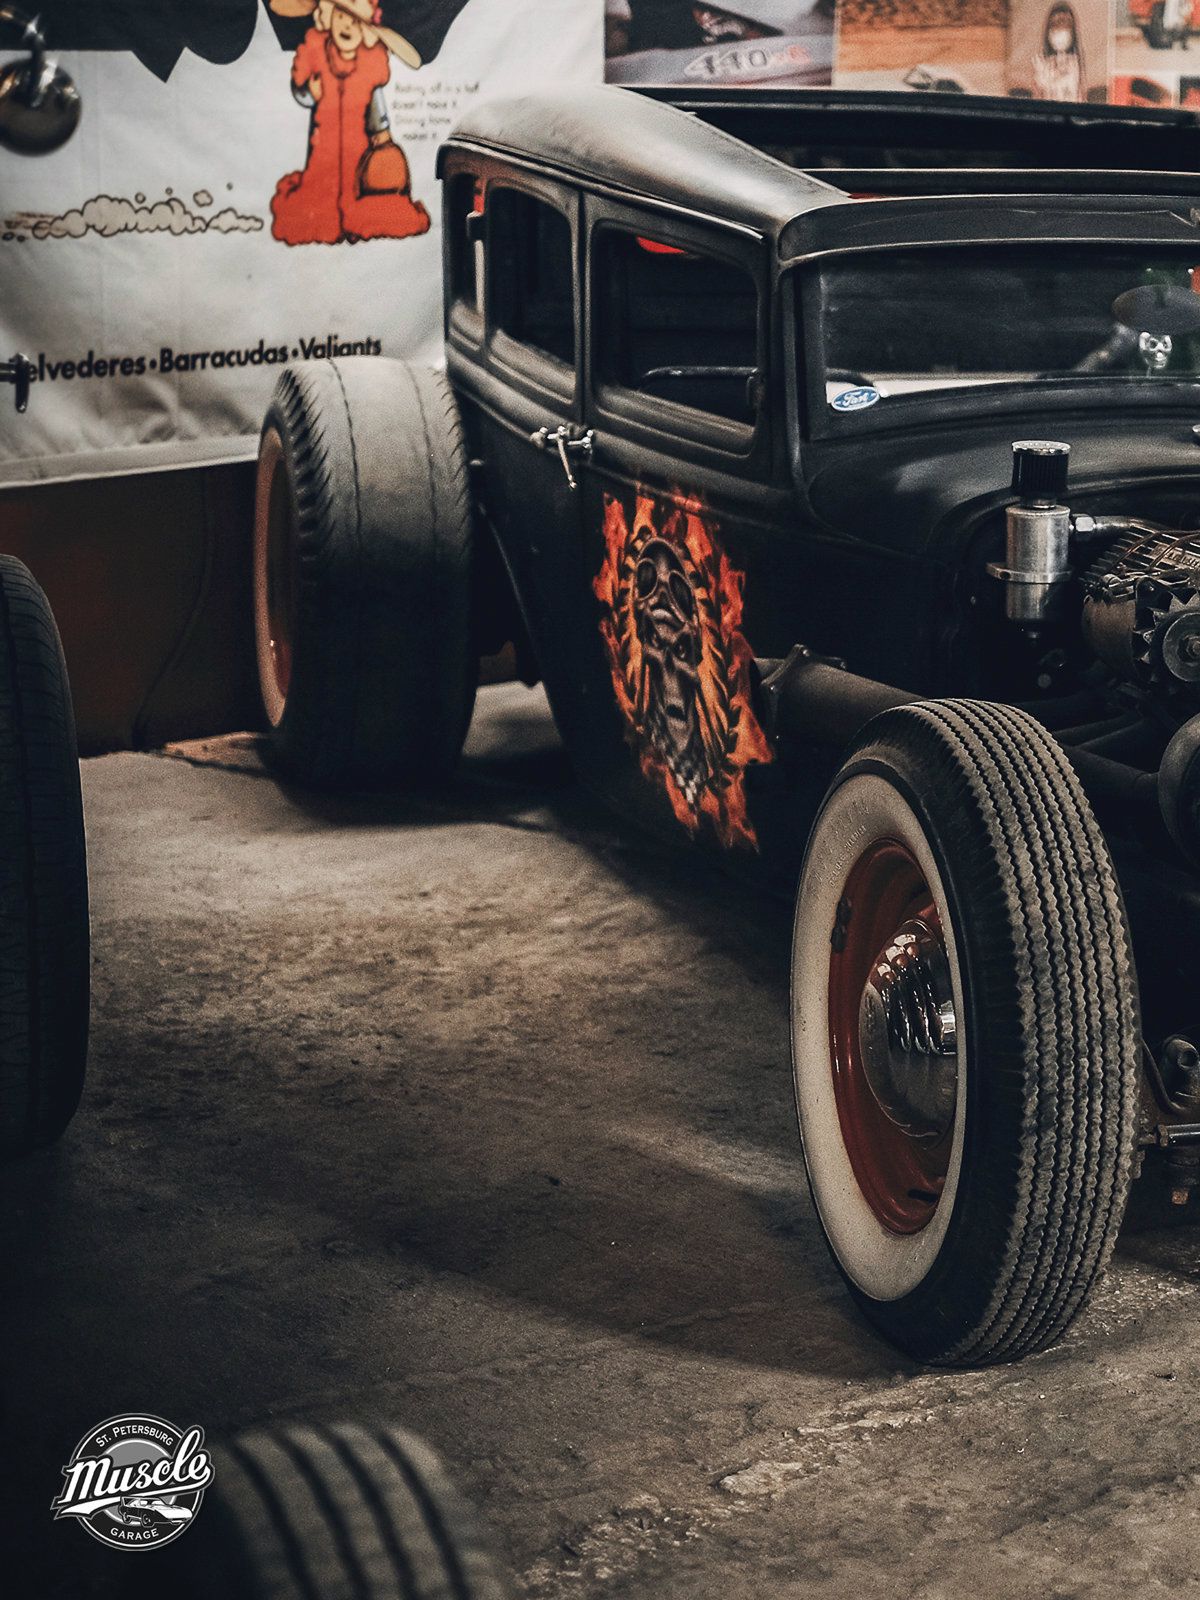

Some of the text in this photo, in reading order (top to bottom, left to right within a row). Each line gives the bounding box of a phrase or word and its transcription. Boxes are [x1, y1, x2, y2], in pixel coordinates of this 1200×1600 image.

[26, 333, 382, 382] elvederes Barracudas Valiants
